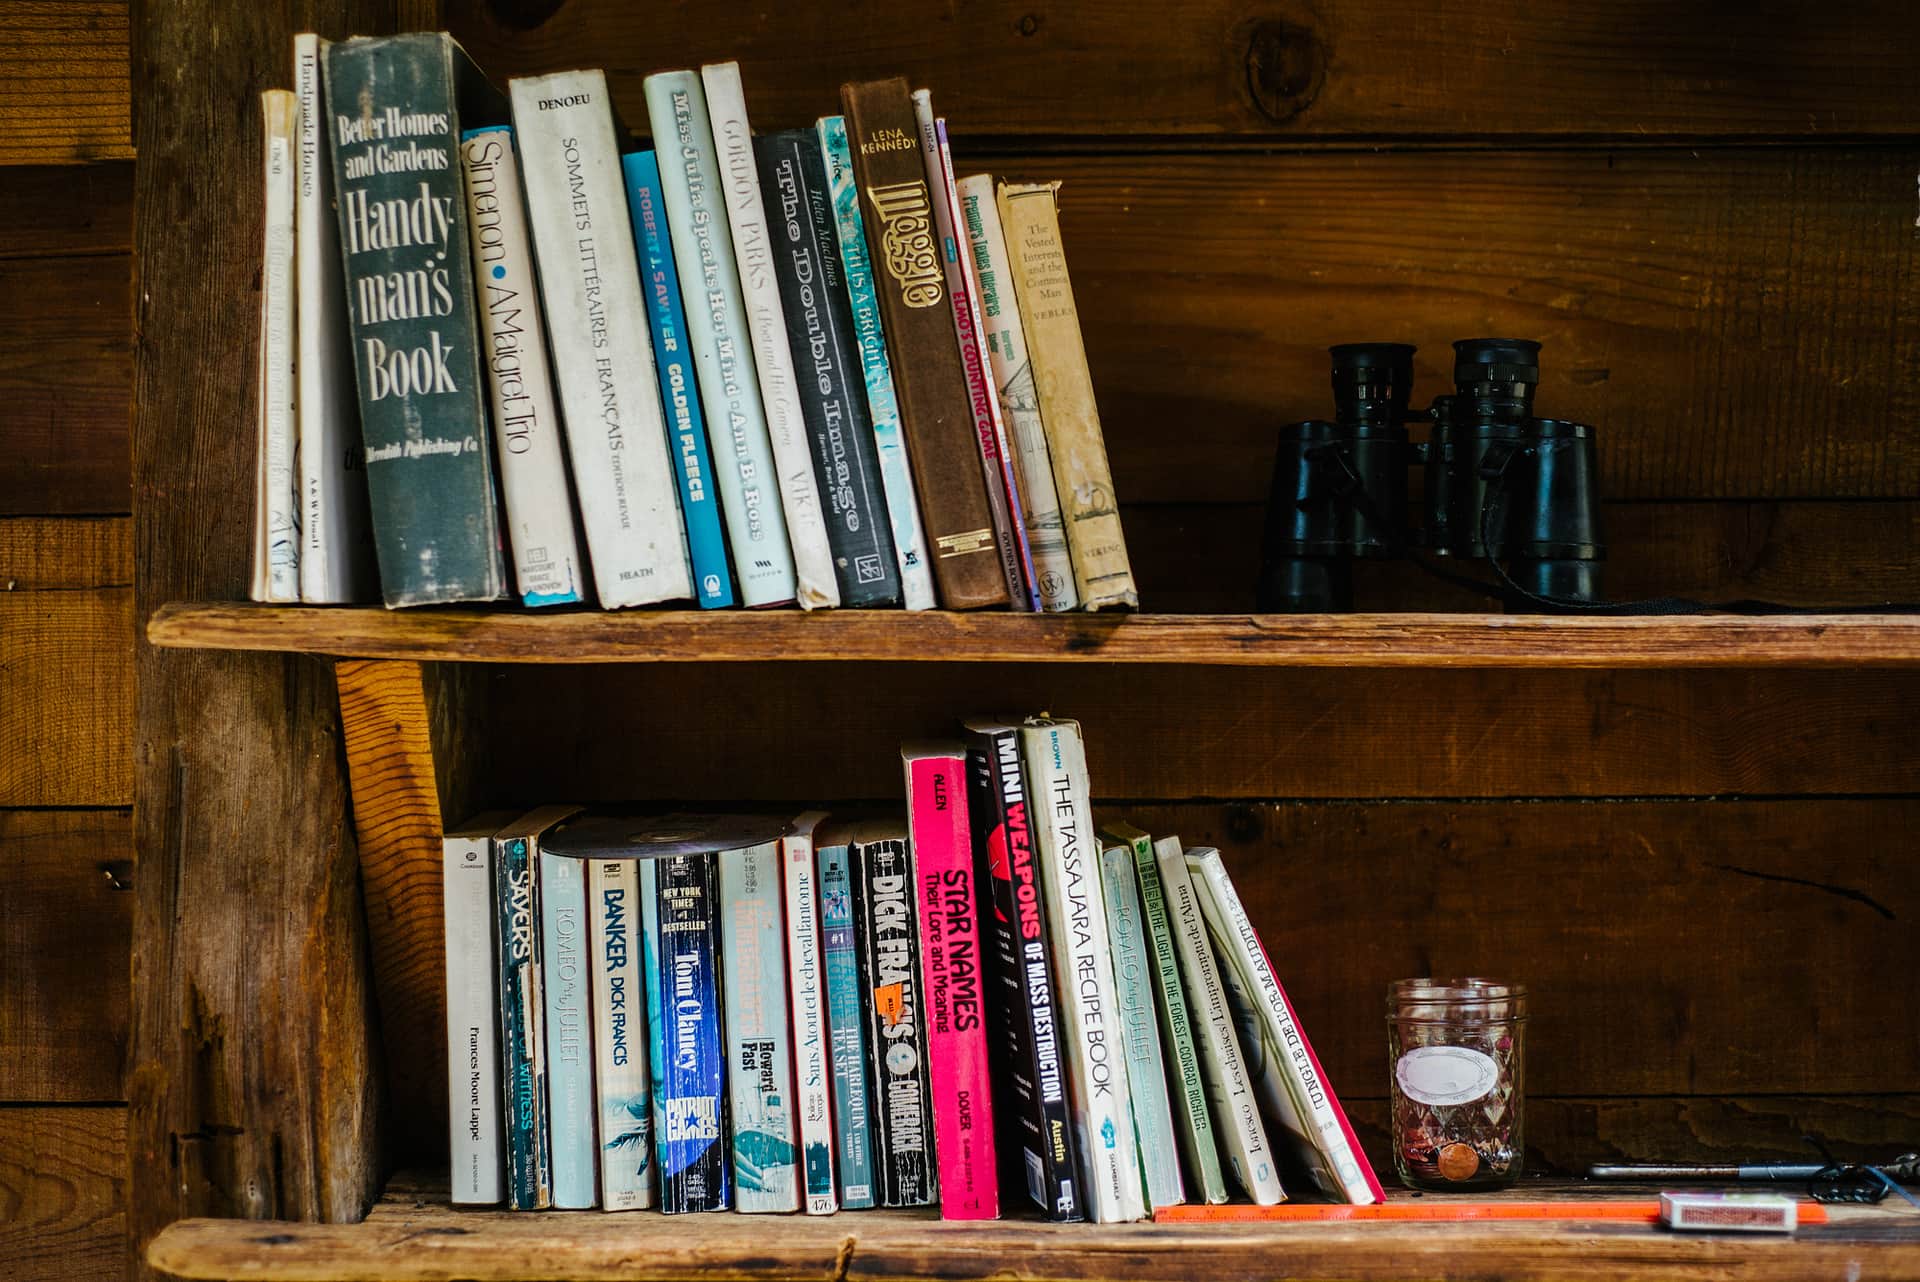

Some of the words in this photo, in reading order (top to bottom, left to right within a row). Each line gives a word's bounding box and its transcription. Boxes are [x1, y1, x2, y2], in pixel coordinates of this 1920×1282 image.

[301, 55, 316, 137] Handmade
[538, 94, 590, 111] DENOEU
[337, 114, 384, 146] Better
[384, 106, 448, 139] Homes
[673, 93, 695, 144] Miss
[872, 127, 904, 142] LENA
[301, 141, 316, 197] Houses
[344, 144, 374, 180] and
[374, 142, 447, 176] Gardens
[831, 153, 843, 180] Price
[860, 138, 918, 156] KENNEDY
[683, 148, 705, 206] Julia
[467, 142, 506, 262] Simenon
[639, 187, 659, 252] ROBERT
[722, 119, 753, 209] GORDON
[740, 222, 769, 289] PARKS
[810, 189, 828, 224] Helen
[962, 196, 983, 240] Premiers
[692, 211, 722, 288] Speaks
[867, 180, 944, 308] Maggie
[1025, 235, 1055, 249] Vested
[1026, 224, 1048, 235] The
[650, 257, 662, 268] J.
[818, 229, 840, 288] MacInnes
[971, 241, 990, 270] Textes
[1023, 251, 1062, 263] Interests
[1029, 263, 1045, 275] and
[1047, 261, 1062, 272] the
[357, 259, 452, 326] man's
[486, 286, 518, 308] A
[562, 138, 592, 231] SOMMETS
[578, 238, 608, 348] LITTÉRAIRES
[596, 358, 624, 450] FRANÇAIS
[852, 273, 866, 287] IS
[855, 293, 868, 304] A
[1040, 287, 1062, 300] Man
[653, 271, 678, 352] SAWYER
[709, 291, 728, 336] Her
[491, 309, 530, 410] Maigret
[776, 160, 802, 242] The
[792, 248, 833, 395] Double
[823, 401, 860, 531] Image
[857, 308, 884, 372] BRIGHT
[362, 331, 457, 400] Book
[716, 338, 737, 396] Mind
[952, 291, 974, 340] ELMO'S
[963, 343, 987, 415] COUNTING
[977, 419, 997, 459] GAME
[505, 405, 537, 454] Trio
[667, 363, 692, 430] GOLDEN
[680, 434, 704, 502] FLEECE
[729, 412, 748, 459] Ann
[773, 398, 792, 446] Camera
[739, 462, 756, 485] B.
[743, 488, 764, 541] Ross
[1001, 531, 1014, 566] GOLDEN
[619, 567, 653, 581] HEATH
[997, 737, 1023, 803] MINI
[1050, 731, 1062, 769] BROWN
[933, 774, 947, 811] ALLEN
[1053, 774, 1074, 818] THE
[663, 888, 678, 899] NEW
[680, 886, 702, 897] YORK
[925, 872, 942, 907] Their
[1007, 803, 1041, 939] WEAPONS
[1059, 820, 1092, 948] TASSAJARA
[508, 870, 530, 959] SAYERS
[671, 899, 694, 910] TIMES
[873, 875, 907, 933] DICK
[943, 869, 973, 935] STAR
[1151, 912, 1166, 930] THE
[556, 907, 577, 980] ROMEO
[604, 888, 627, 972] BANKER
[663, 921, 706, 933] BESTSELLER
[832, 932, 844, 945] #1
[928, 911, 943, 942] Lore
[1114, 905, 1140, 983] ROMEO
[1155, 934, 1171, 961] LIGHT
[1188, 925, 1201, 940] de
[796, 935, 815, 979] cheval
[931, 948, 947, 970] and
[1024, 943, 1043, 959] OF
[1162, 966, 1174, 976] IN
[1239, 924, 1274, 991] MAUDIT
[610, 977, 625, 1010] DICK
[673, 951, 699, 996] Tom
[799, 982, 815, 994] le
[950, 941, 980, 1032] NAMES
[1026, 962, 1049, 1006] MASS
[1077, 955, 1102, 1024] RECIPE
[1166, 981, 1180, 999] THE
[932, 975, 951, 1033] Meaning
[1170, 1002, 1187, 1038] FOREST
[470, 1027, 480, 1069] Frances
[554, 1004, 580, 1066] JULIET
[611, 1012, 627, 1066] FRANCIS
[675, 1002, 701, 1073] Clancy
[803, 1011, 819, 1050] Atout
[833, 1026, 847, 1053] TEA
[846, 1027, 858, 1053] THE
[1122, 1003, 1152, 1064] JULIET
[1282, 1024, 1300, 1046] DE
[741, 1042, 759, 1071] Fast
[760, 1042, 777, 1093] Howard
[805, 1052, 820, 1086] Sans
[835, 1055, 848, 1080] SET
[1032, 1006, 1062, 1103] DESTRUCTION
[1087, 1031, 1112, 1098] BOOK
[470, 1071, 481, 1105] Moore
[520, 1061, 533, 1129] WITNESS
[666, 1097, 717, 1120] PATRIOT
[847, 1055, 864, 1130] HARLEQUIN
[1179, 1046, 1199, 1086] CONRAD
[1189, 1090, 1207, 1131] RICHTER
[469, 1108, 482, 1141] Lappé
[667, 1118, 719, 1141] GAMES
[888, 1080, 922, 1154] COMEBACK
[958, 1091, 971, 1131] DOVER
[1241, 1104, 1262, 1153] Ionesco
[1051, 1119, 1066, 1162] Austin
[1109, 1153, 1121, 1200] SHAMBHALA
